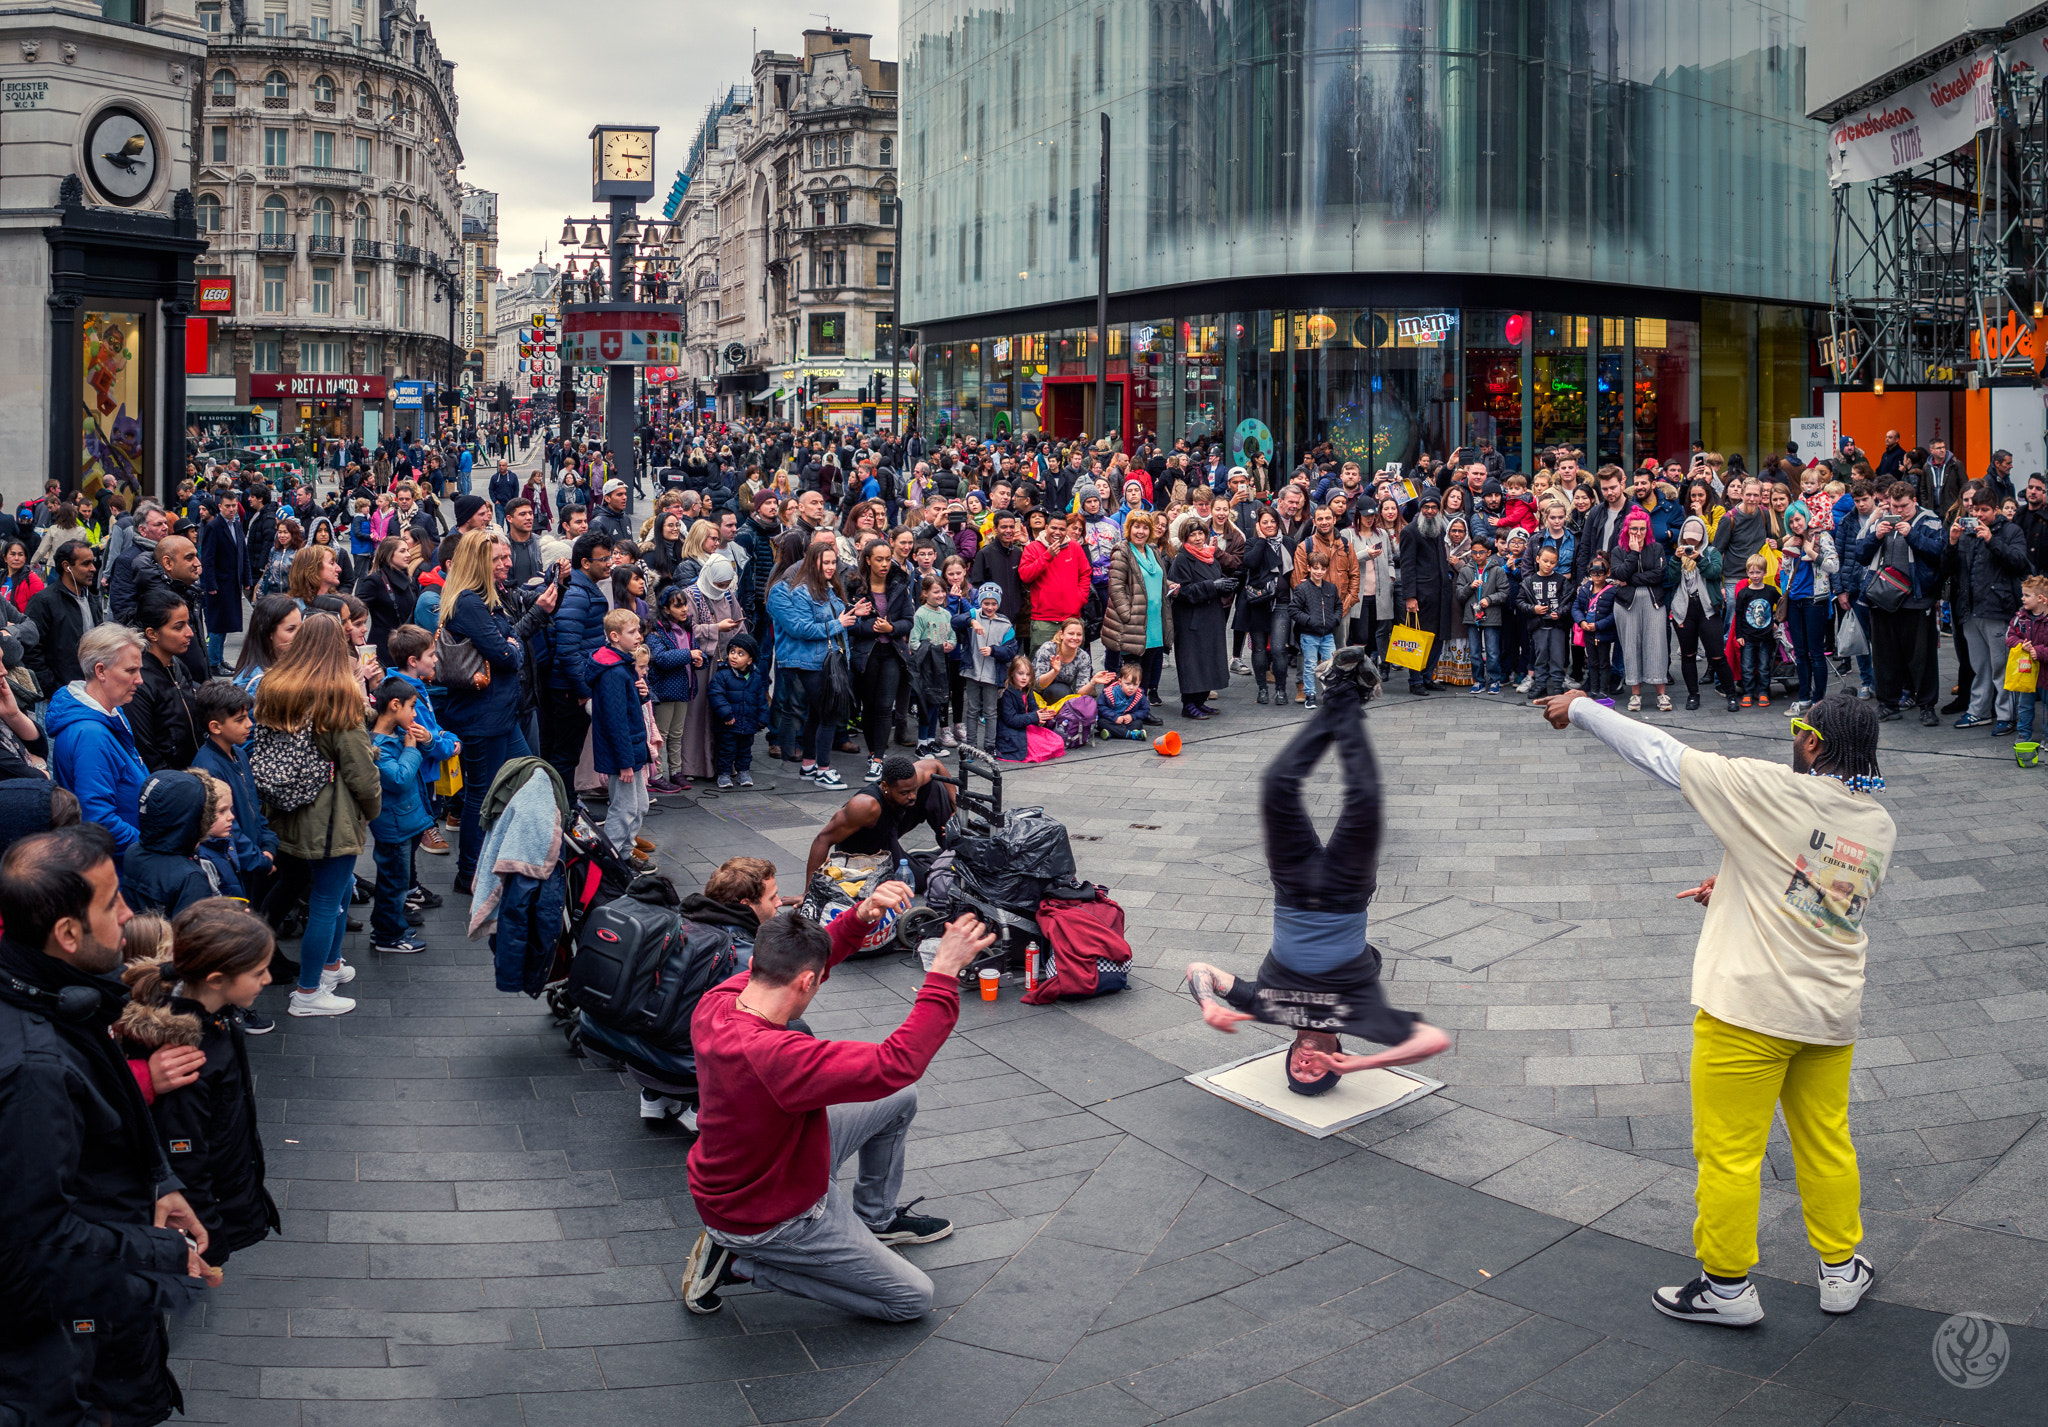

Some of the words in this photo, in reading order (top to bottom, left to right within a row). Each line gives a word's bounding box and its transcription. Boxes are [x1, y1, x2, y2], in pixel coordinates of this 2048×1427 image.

[2, 82, 49, 91] LEICESTER
[5, 91, 45, 101] SQUARE
[1889, 125, 1924, 166] STORE
[466, 244, 474, 261] THE
[466, 265, 474, 291] BOOK
[202, 288, 230, 301] LEGO
[466, 293, 474, 305] OF
[465, 308, 473, 348] MORMON
[802, 368, 823, 378] SHAKE
[823, 368, 846, 378] SHACK
[291, 378, 315, 394] PRET
[316, 378, 323, 394] A
[400, 387, 419, 396] MONEY
[396, 396, 423, 405] EXCHANGE
[1823, 856, 1847, 870] CHECK
[1847, 862, 1857, 873] ME
[1857, 867, 1870, 877] OUT
